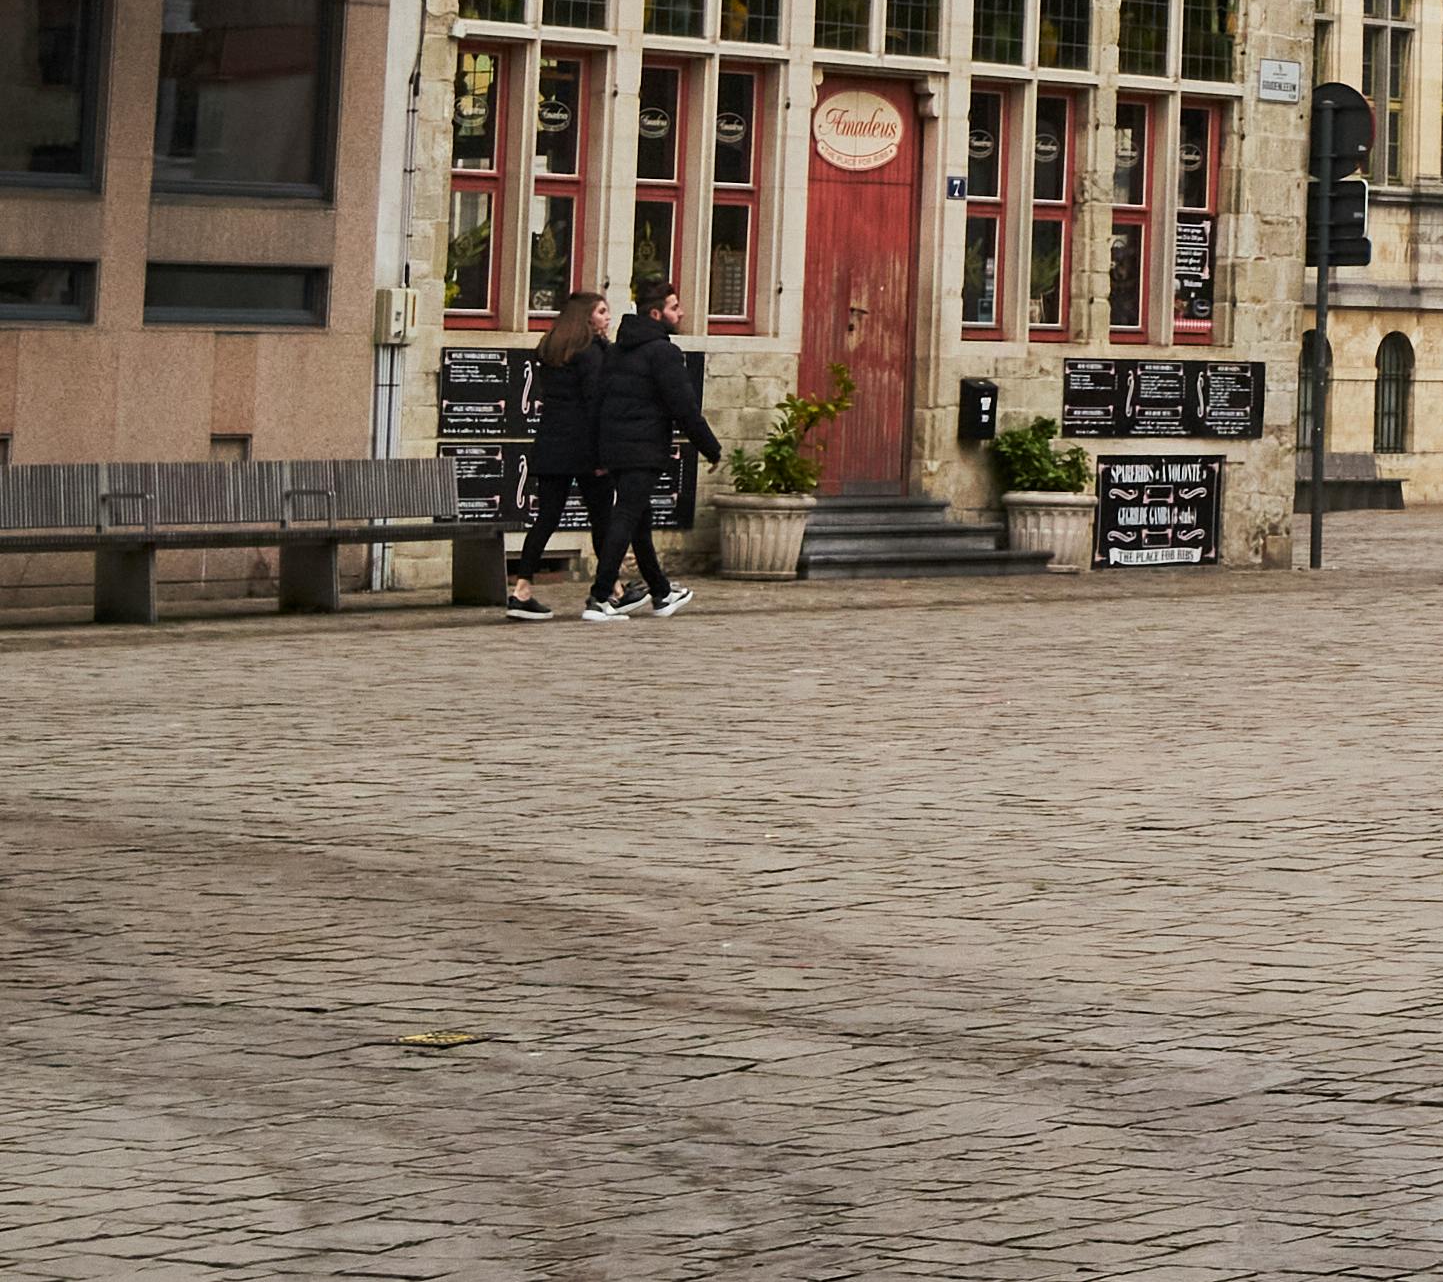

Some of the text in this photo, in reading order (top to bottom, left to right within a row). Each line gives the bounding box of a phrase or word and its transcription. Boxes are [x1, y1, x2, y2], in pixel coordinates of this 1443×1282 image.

[818, 107, 897, 139] Amadeus
[953, 180, 961, 196] 7
[1118, 549, 1194, 563] THE PLACE FOR RIBS
